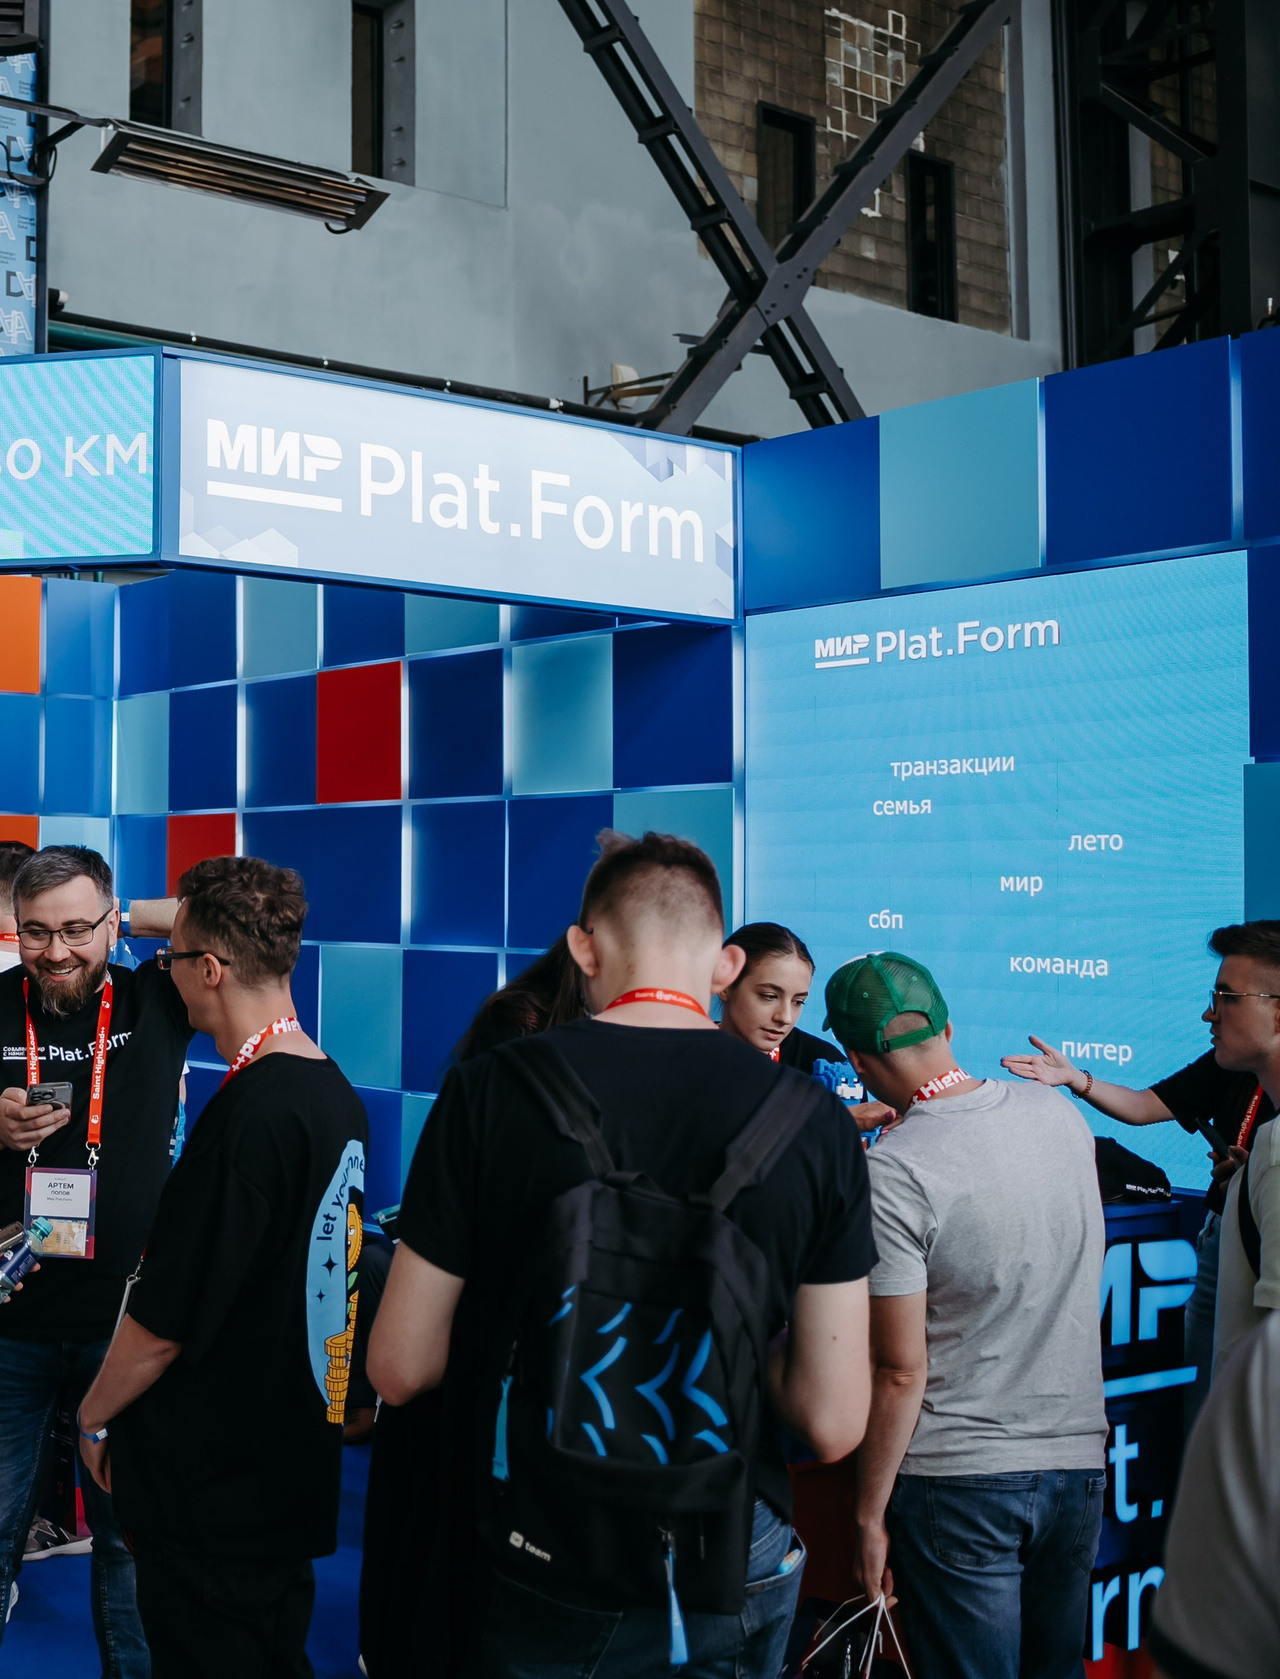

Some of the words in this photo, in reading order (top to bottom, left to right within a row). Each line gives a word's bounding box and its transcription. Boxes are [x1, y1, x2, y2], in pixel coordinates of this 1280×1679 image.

[360, 443, 705, 564] Plat.Form
[875, 619, 1060, 663] Plat.Form
[890, 755, 1015, 781] транзакции
[872, 797, 932, 816] семья
[1068, 832, 1123, 852] лето
[1000, 874, 1043, 895] мир
[868, 909, 903, 930] сбп
[1009, 955, 1109, 977] команда
[94, 1026, 106, 1074] HighLoad++
[1061, 1039, 1132, 1062] питер
[92, 1075, 102, 1100] Saint
[48, 1182, 74, 1190] АРТЕМ
[316, 1213, 337, 1240] let
